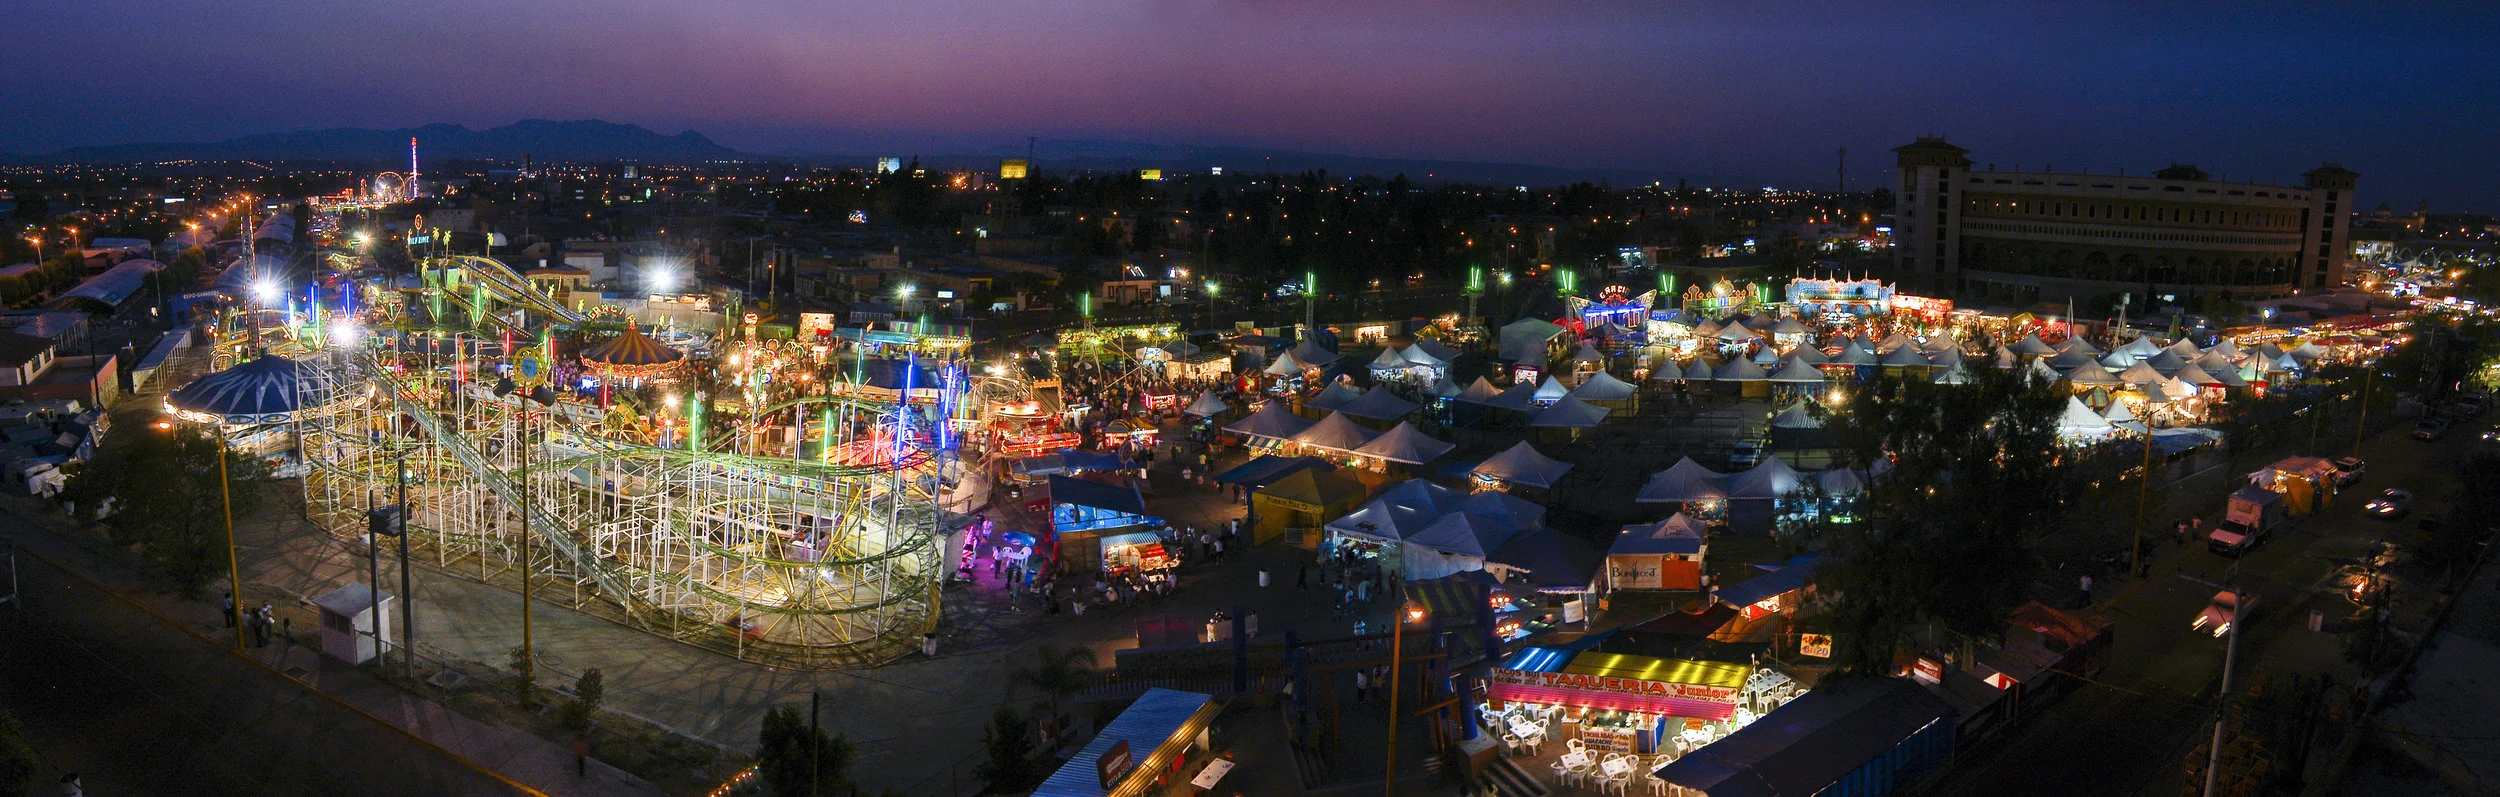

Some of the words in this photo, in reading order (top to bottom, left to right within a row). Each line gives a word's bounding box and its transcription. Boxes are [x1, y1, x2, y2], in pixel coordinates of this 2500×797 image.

[1494, 668, 1522, 677] TACOS
[1541, 673, 1667, 694] TAQUERIA
[1585, 744, 1611, 752] BURRO
